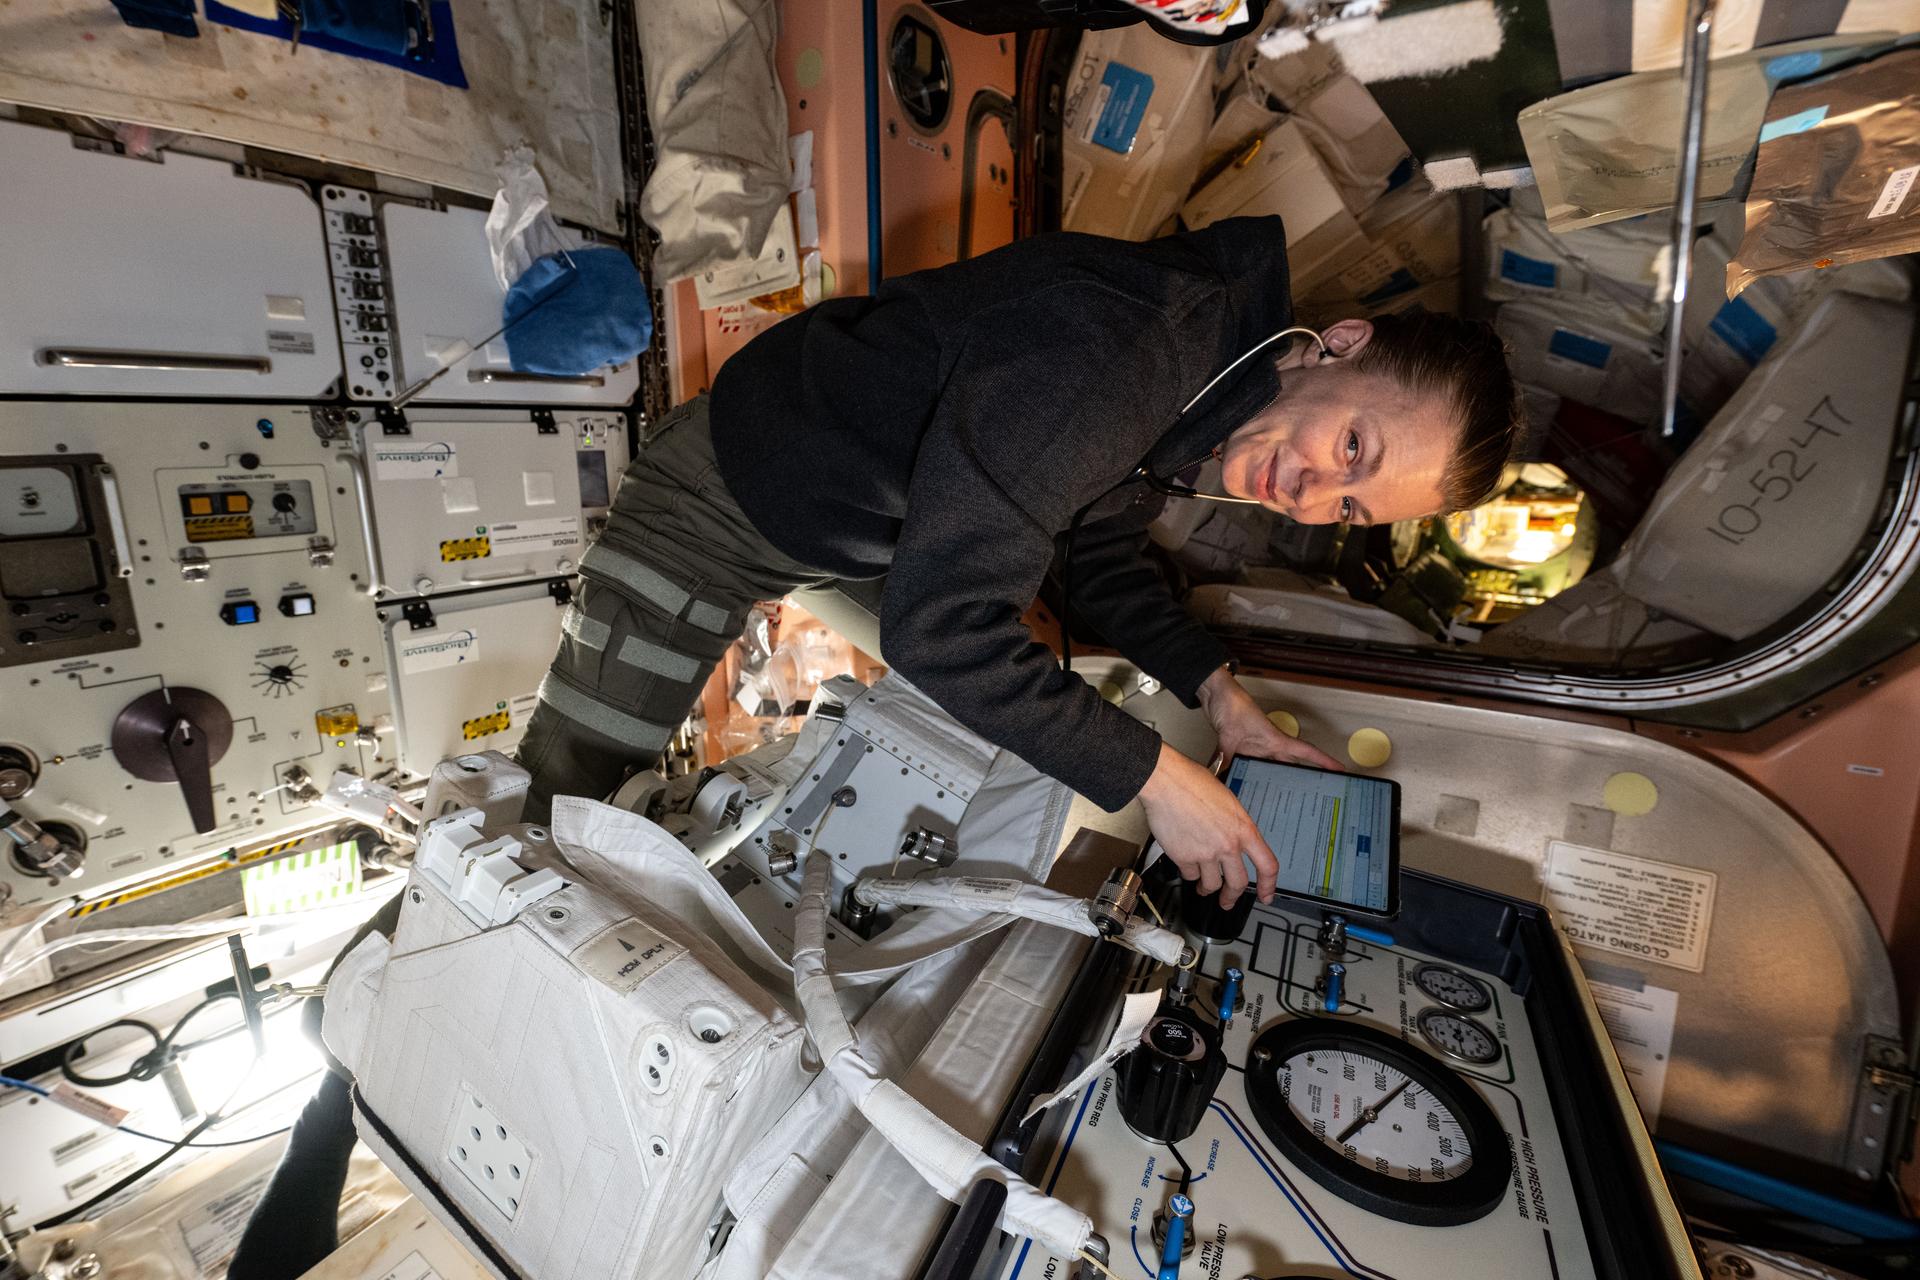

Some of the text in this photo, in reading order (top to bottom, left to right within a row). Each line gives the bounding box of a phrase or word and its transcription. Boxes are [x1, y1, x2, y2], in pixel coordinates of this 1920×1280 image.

[552, 537, 578, 546] FRIDGE
[641, 944, 664, 960] DPLY
[1609, 937, 1669, 957] CLOSING
[1344, 1063, 1356, 1081] 1000
[1374, 1072, 1386, 1092] 2000
[1088, 1076, 1114, 1128] LOW PRES REG
[1404, 1089, 1416, 1110] 3000
[1426, 1111, 1440, 1132] 4000
[1208, 1138, 1220, 1171] DECREASE
[1439, 1136, 1452, 1157] 5000
[1141, 1156, 1156, 1188] INCREASE
[1431, 1158, 1445, 1180] 6000
[1521, 1139, 1549, 1224] HIGH PRESSURE
[1130, 1198, 1142, 1222] CLOSE
[1515, 1188, 1529, 1220] GAUGE
[1216, 1223, 1228, 1246] LOW
[1200, 1240, 1213, 1270] VALVE
